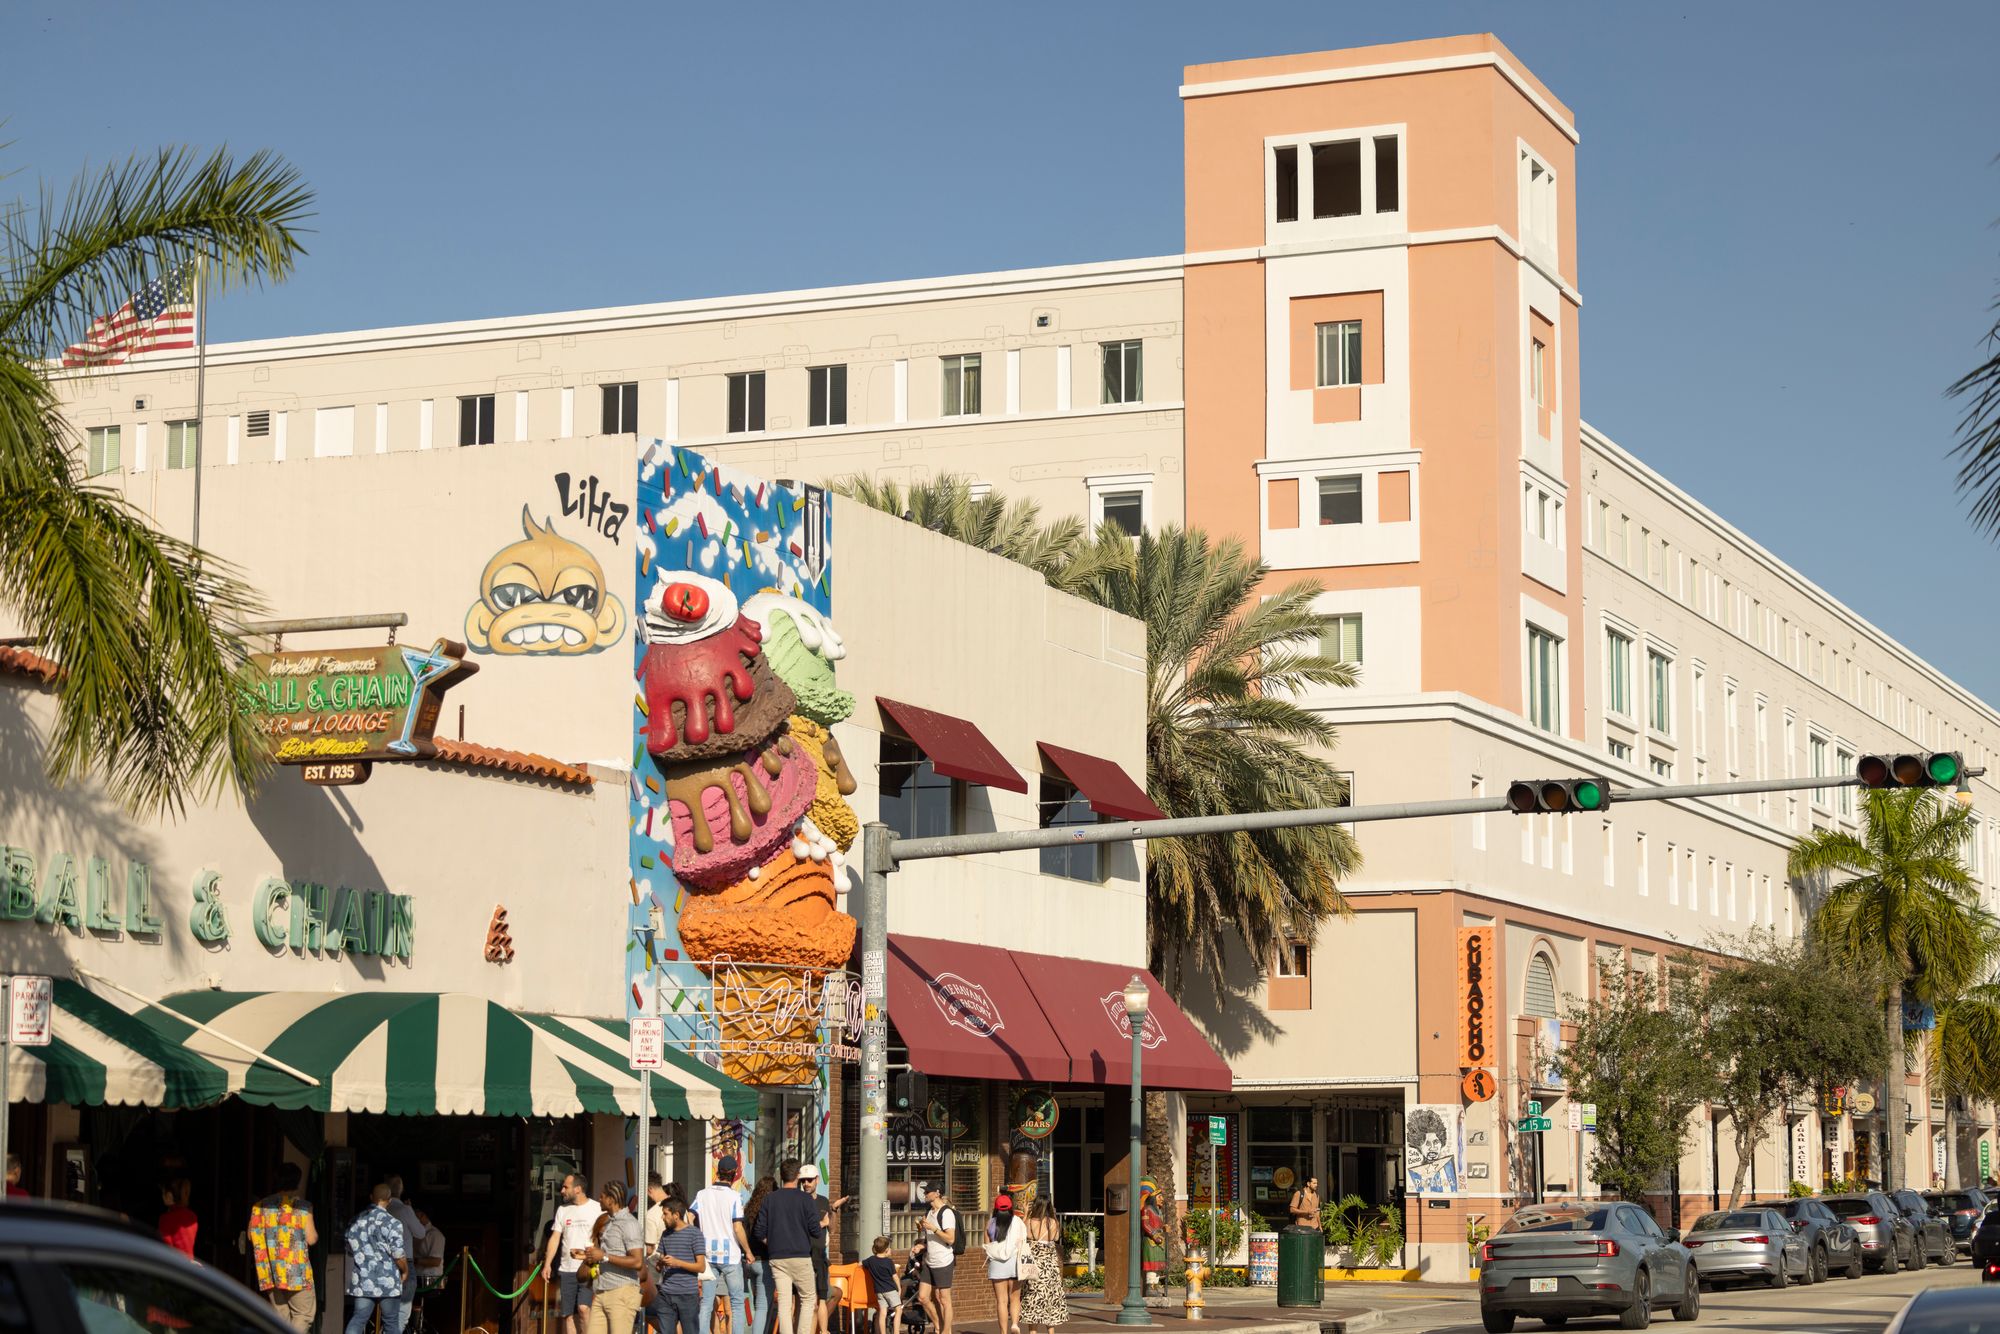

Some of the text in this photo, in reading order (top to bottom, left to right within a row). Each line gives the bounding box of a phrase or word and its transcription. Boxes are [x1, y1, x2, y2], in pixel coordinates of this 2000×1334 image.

[239, 673, 411, 714] ALL & CHAIN
[312, 711, 395, 734] LOUNGE
[304, 764, 356, 781] EST. 1935
[0, 845, 416, 958] BALL & CHAIN
[16, 992, 48, 1000] PARKING
[27, 981, 37, 989] NO
[24, 1003, 38, 1011] ANY
[953, 984, 990, 1010] HAVANA
[1467, 934, 1485, 1062] CUBAOCHO
[23, 1013, 39, 1021] TIME
[1529, 1120, 1539, 1130] 15
[1542, 1119, 1551, 1128] AV
[887, 1133, 942, 1161] IGARS
[1797, 1145, 1806, 1179] FACTORY
